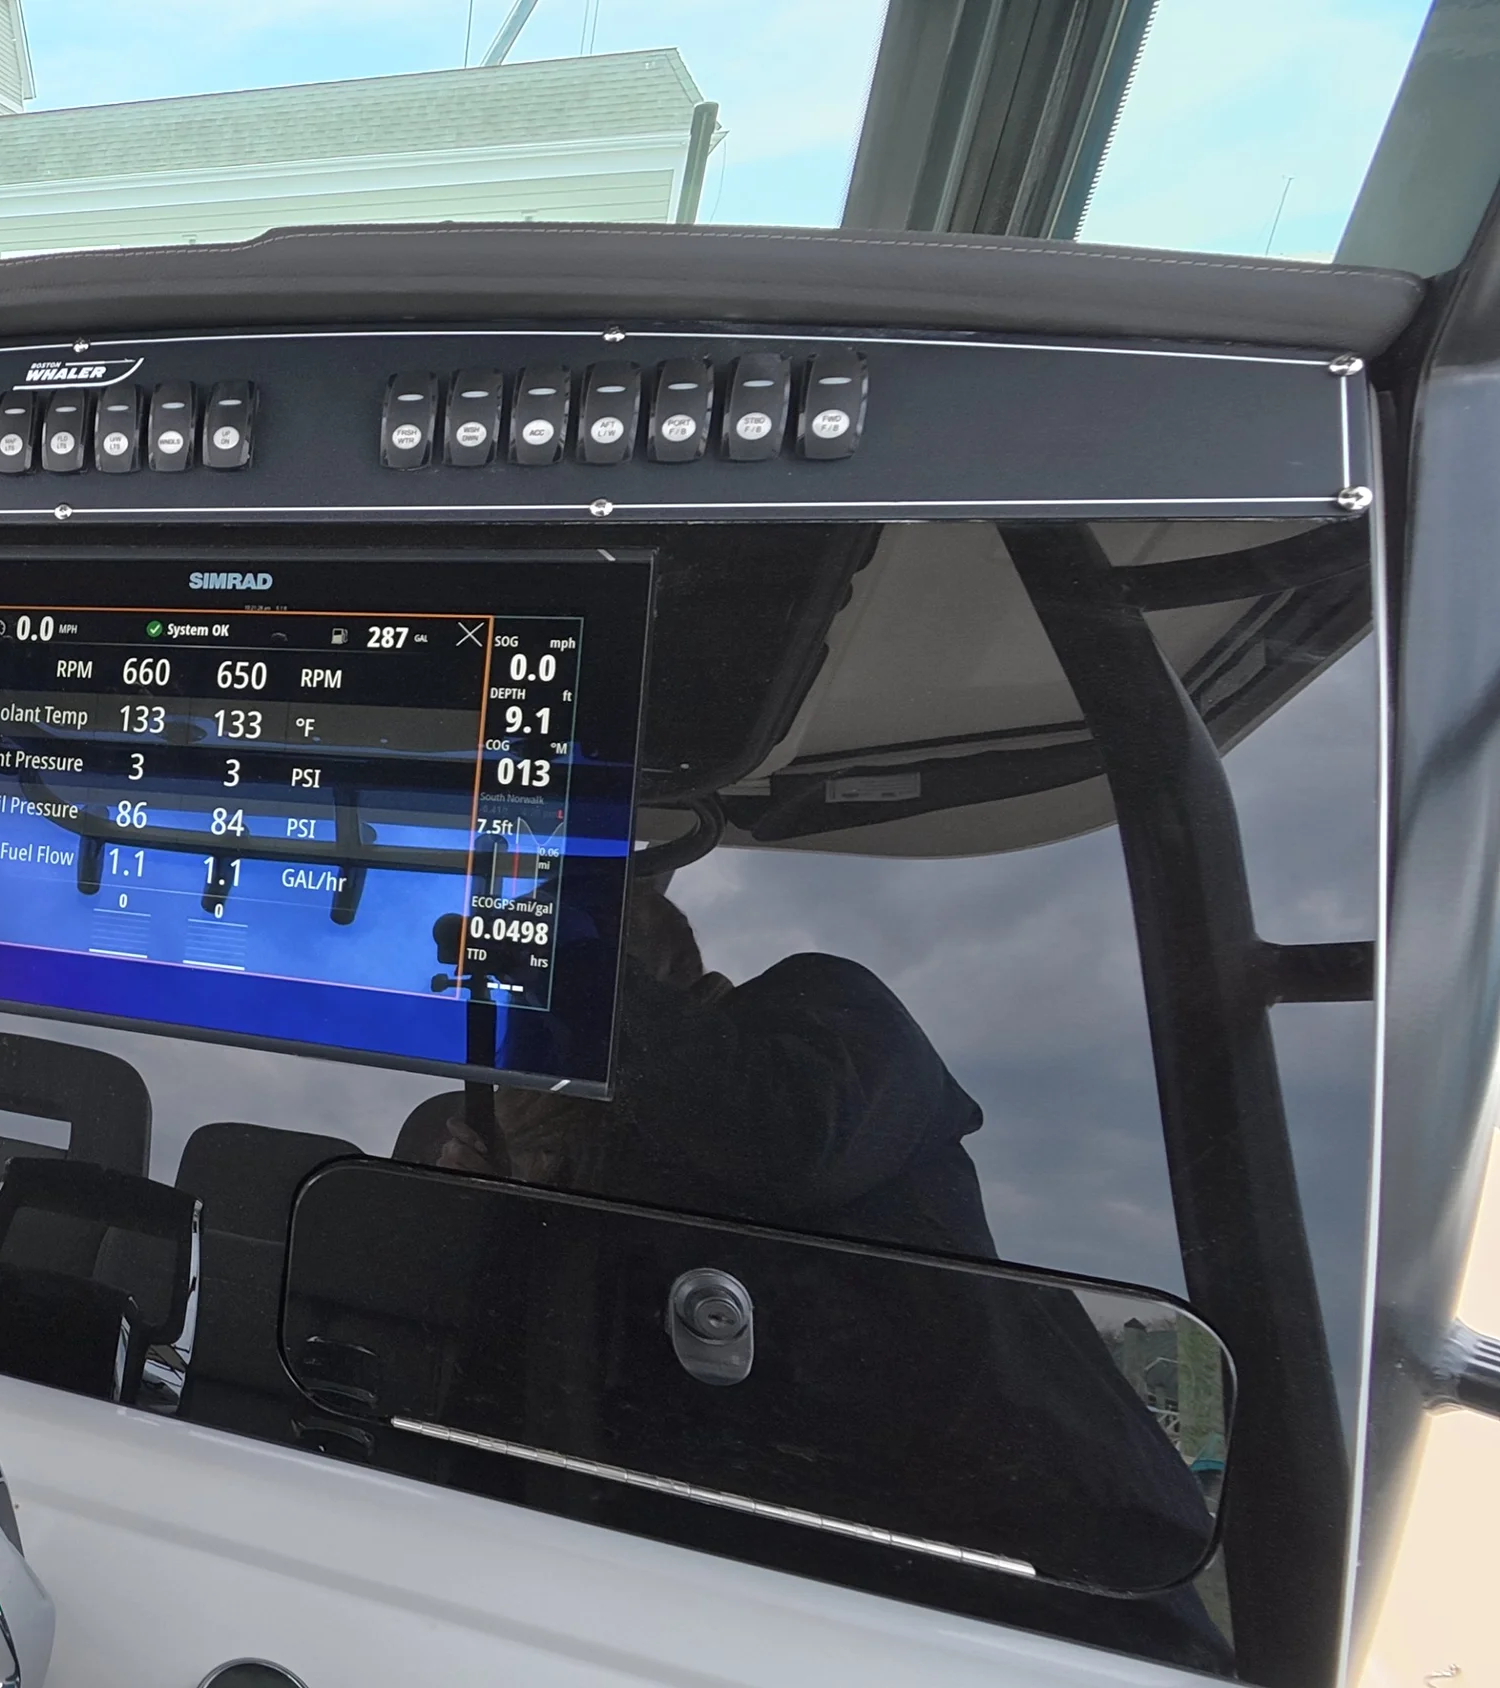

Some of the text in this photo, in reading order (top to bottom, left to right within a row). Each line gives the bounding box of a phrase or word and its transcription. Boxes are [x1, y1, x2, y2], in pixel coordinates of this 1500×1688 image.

[25, 366, 107, 382] WHALER
[667, 418, 692, 427] PORT
[744, 416, 766, 425] STBD
[821, 415, 842, 423] FWD
[189, 572, 273, 590] SIMRAD
[16, 615, 78, 643] 0.0 MPH
[167, 622, 230, 639] System OK
[366, 626, 428, 649] 287 GAL
[494, 635, 576, 652] SOG mph
[56, 657, 343, 690] RPM 660 650 RPM
[510, 653, 556, 682] 0.0
[490, 687, 573, 702] DEPTH ft
[44, 705, 88, 729] Temp
[119, 705, 166, 734] 133
[213, 708, 263, 739] 133
[295, 718, 315, 737] °F
[505, 706, 551, 734] 9.1
[485, 739, 567, 754] COG °M
[15, 750, 84, 773] Pressure
[128, 752, 145, 781] 3
[223, 758, 241, 787] 3
[290, 767, 321, 789] PSI
[497, 757, 551, 787] 013
[480, 791, 545, 805] South Norwalk
[10, 796, 79, 819] Pressure
[116, 800, 148, 829] 86
[210, 807, 245, 837] 84
[286, 818, 316, 839] PSI
[477, 818, 514, 836] 7.5ft
[539, 848, 560, 858] 0.06
[0, 842, 347, 893] Fuel Flow 1.1 1.1 GAL/hr
[538, 861, 551, 870] mi
[119, 893, 128, 909] 0
[471, 896, 553, 917] ECOGPS mi/gal
[214, 903, 223, 919] 0
[470, 916, 549, 945] 0.0498
[467, 948, 549, 968] TTD hrs
